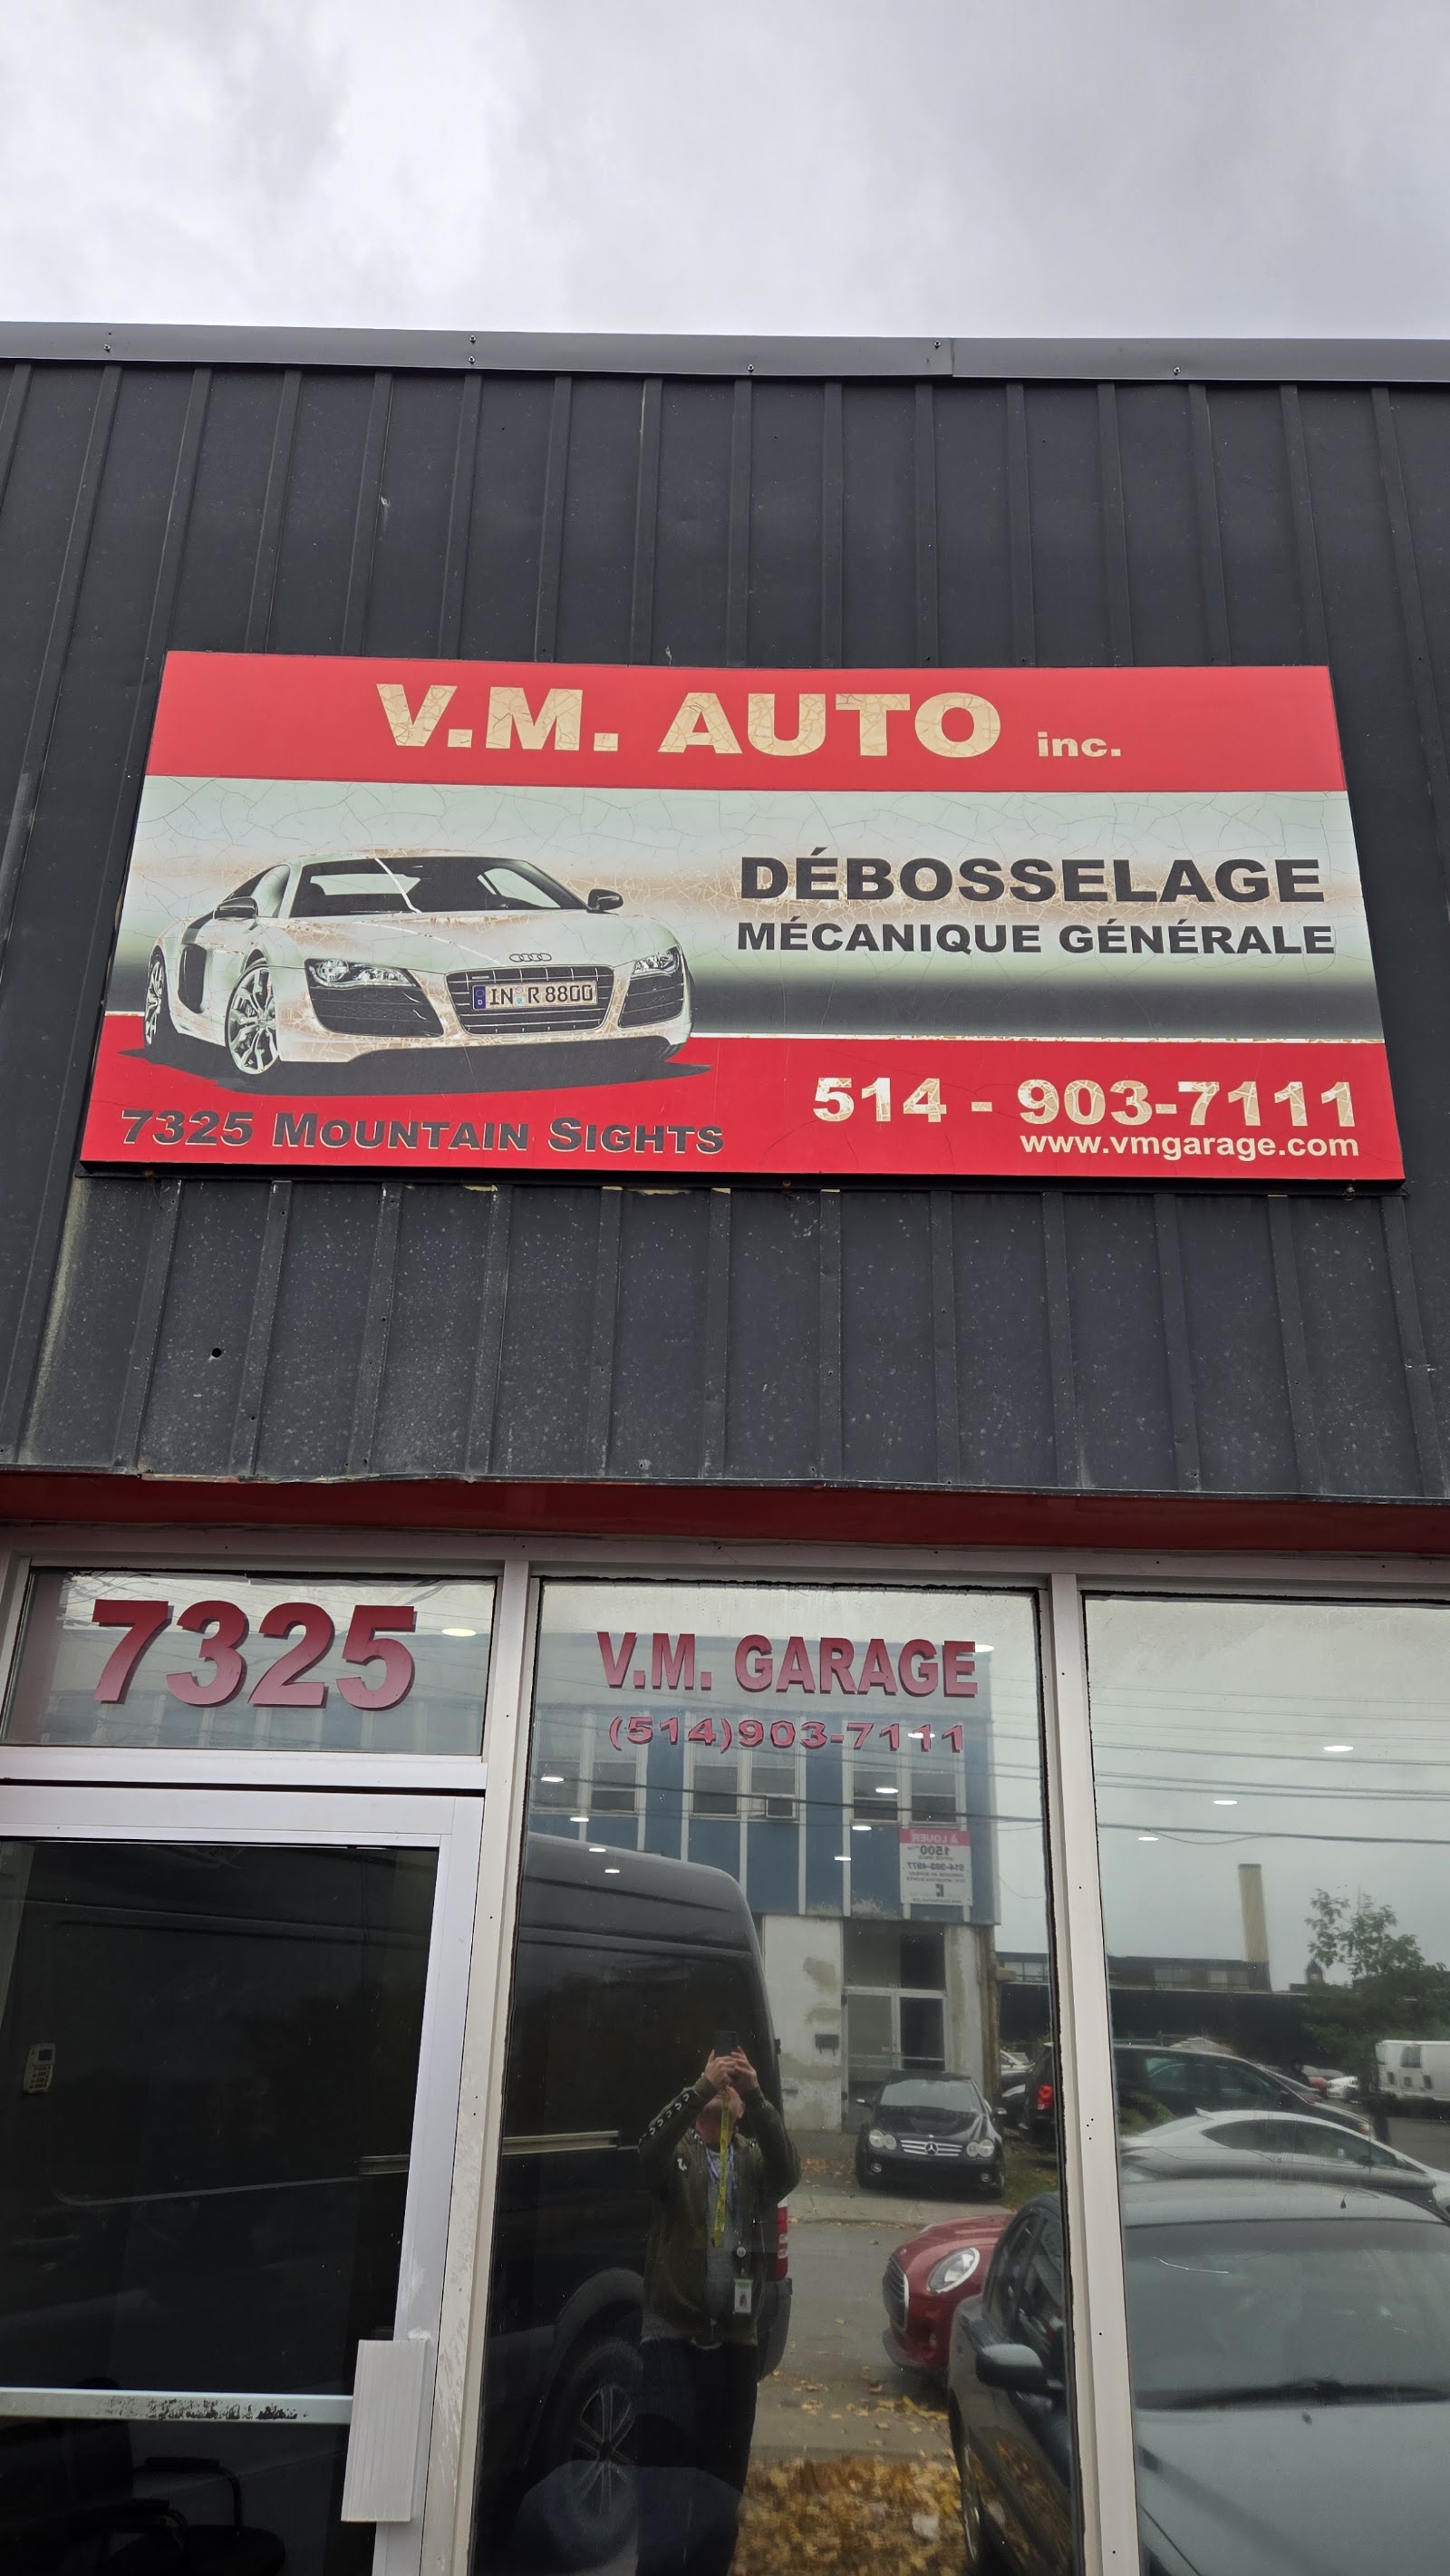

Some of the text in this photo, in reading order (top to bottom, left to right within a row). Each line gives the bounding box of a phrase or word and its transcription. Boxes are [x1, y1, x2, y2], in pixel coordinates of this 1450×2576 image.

[375, 683, 1122, 758] V.M. AUTO inc.
[740, 847, 1325, 904] DÉBOSSELAGE
[737, 915, 1336, 956] MÉCANIQUE GÉNÉRALE
[489, 987, 514, 1006] IN
[812, 1077, 947, 1123] 514
[1017, 1078, 1356, 1128] 903-7111
[121, 1109, 255, 1148] 7325
[1019, 1130, 1360, 1162] www.vmgarage.com
[91, 1598, 418, 1711] 7325
[596, 1631, 979, 1698] V.M. GARAGE
[609, 1715, 965, 1754] (514)903-7111
